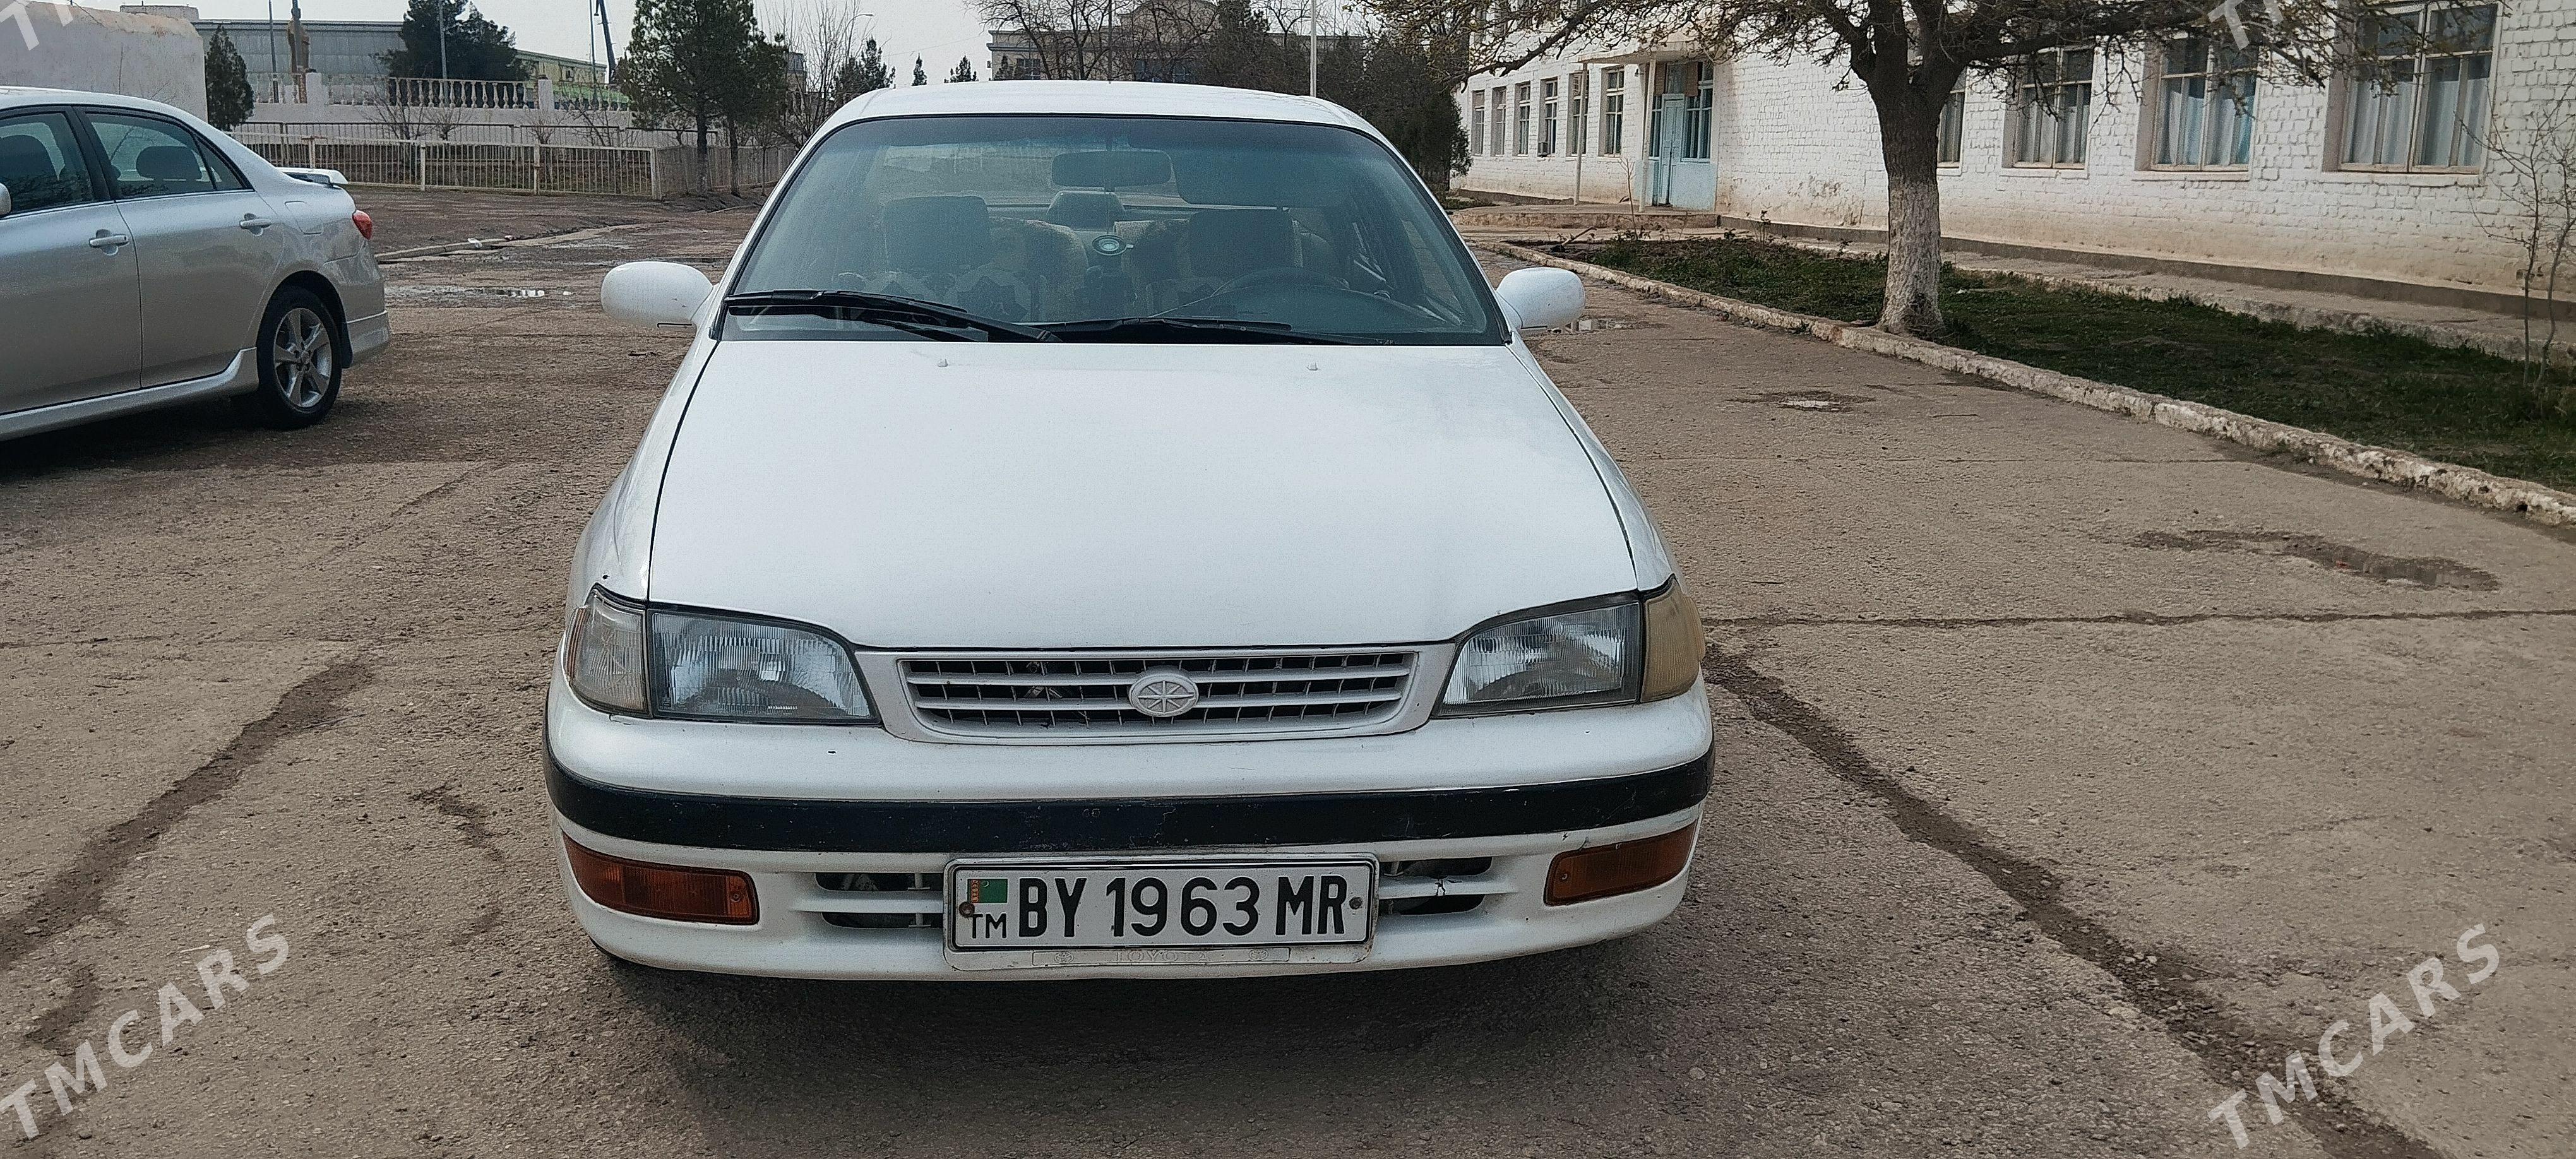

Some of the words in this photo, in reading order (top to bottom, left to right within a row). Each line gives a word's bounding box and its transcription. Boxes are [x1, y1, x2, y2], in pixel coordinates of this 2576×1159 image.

[1018, 877, 1087, 937] BY
[1106, 876, 1260, 937] 1963
[1275, 875, 1347, 936] MR
[967, 913, 1007, 939] TM
[1116, 950, 1209, 963] TOYOTA
